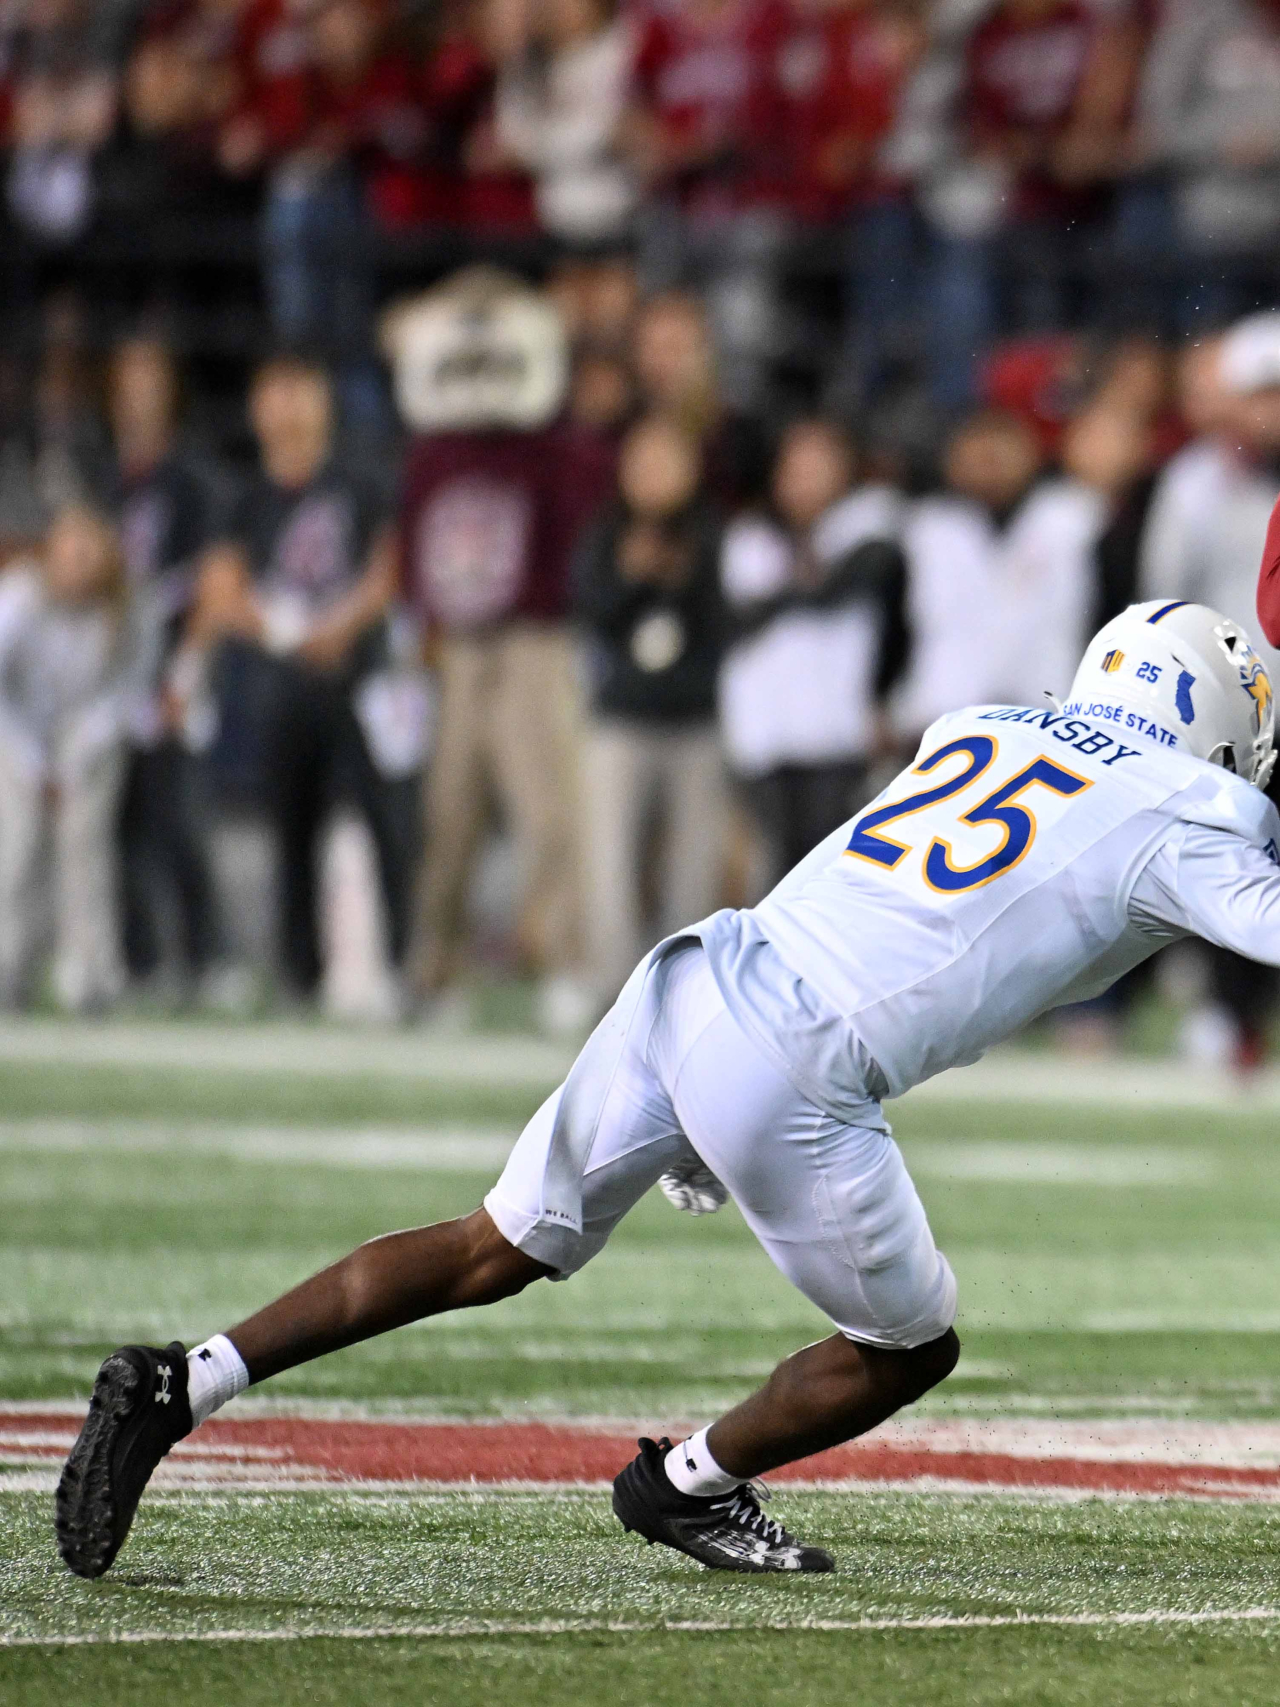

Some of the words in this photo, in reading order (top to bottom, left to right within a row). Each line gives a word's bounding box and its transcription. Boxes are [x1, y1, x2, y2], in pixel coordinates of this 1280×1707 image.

[1135, 661, 1163, 684] 25
[976, 708, 1143, 766] DANSBY
[1084, 703, 1124, 723] JOSÉ
[1125, 713, 1178, 748] STATE
[842, 734, 1095, 895] 25
